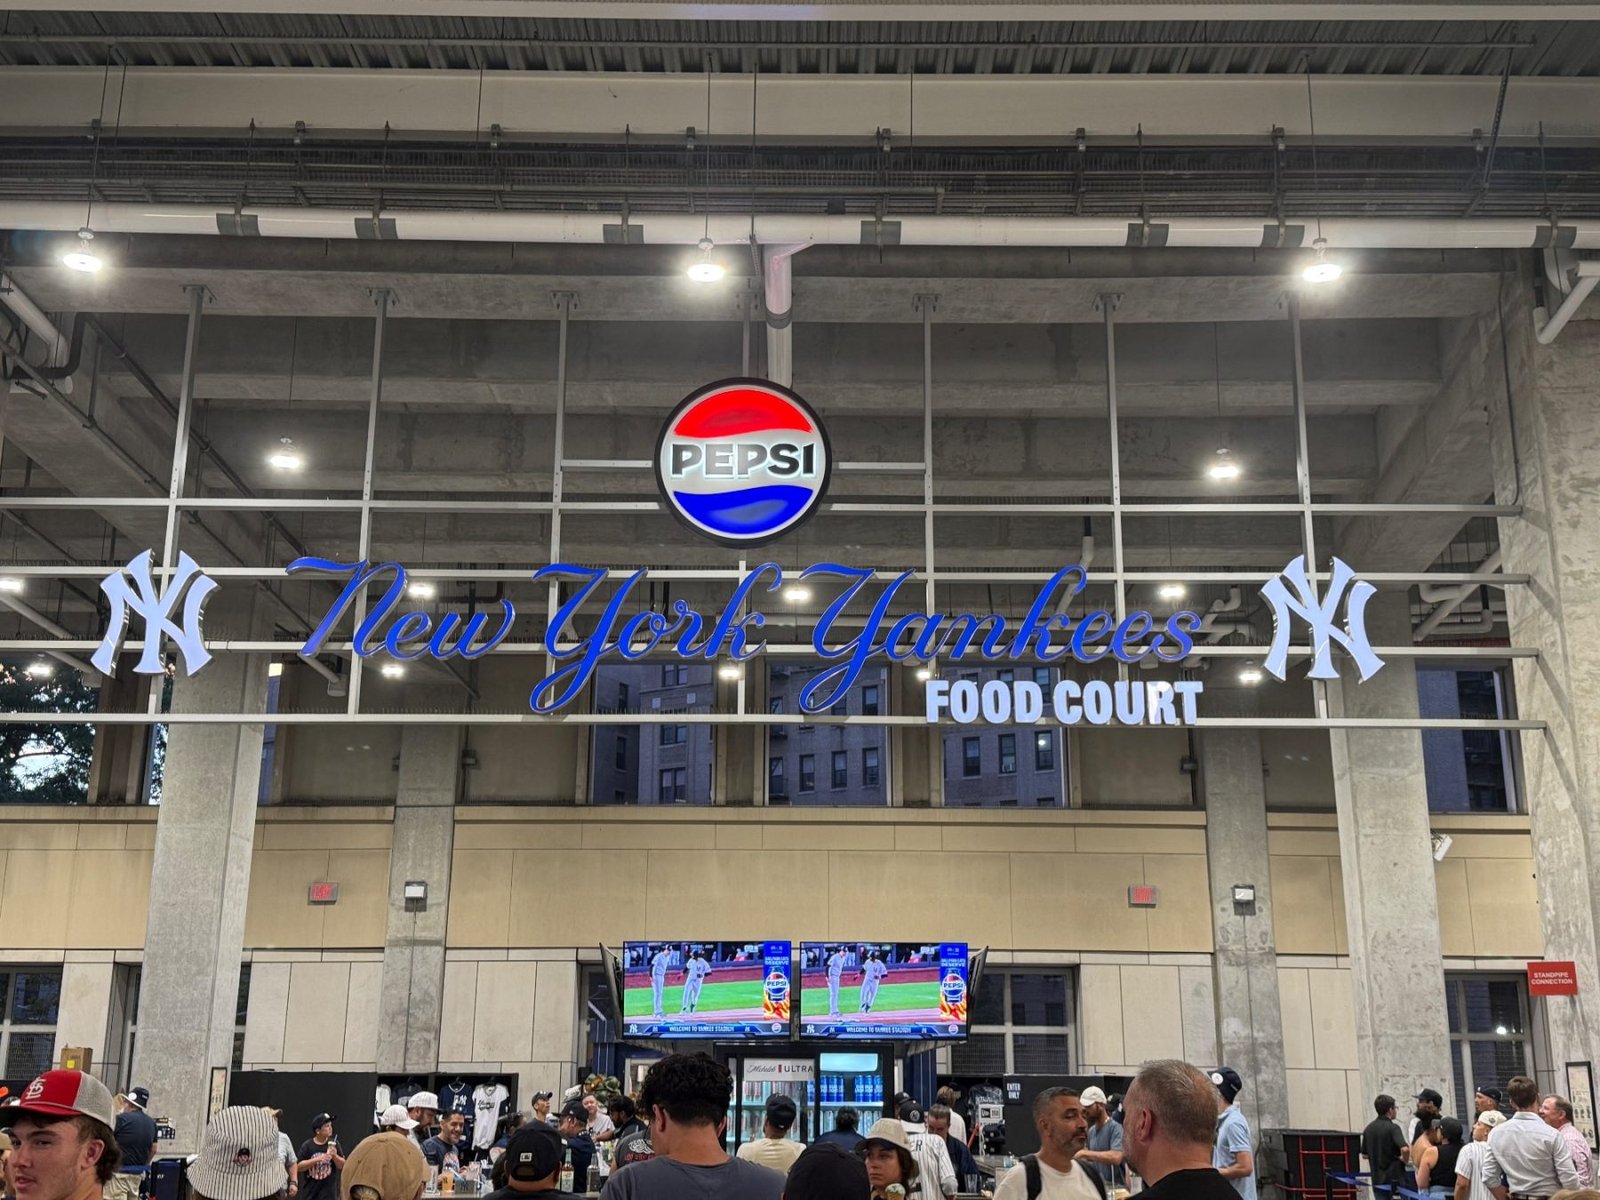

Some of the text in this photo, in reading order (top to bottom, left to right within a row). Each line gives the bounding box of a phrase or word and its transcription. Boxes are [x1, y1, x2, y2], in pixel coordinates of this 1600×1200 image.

[671, 442, 816, 477] PEPSI
[285, 555, 1202, 714] New York Yankees
[925, 680, 1204, 726] FOOD COURT
[784, 1064, 814, 1073] ULTRA
[1006, 1082, 1021, 1092] ENTER
[1008, 1091, 1020, 1100] ONLY
